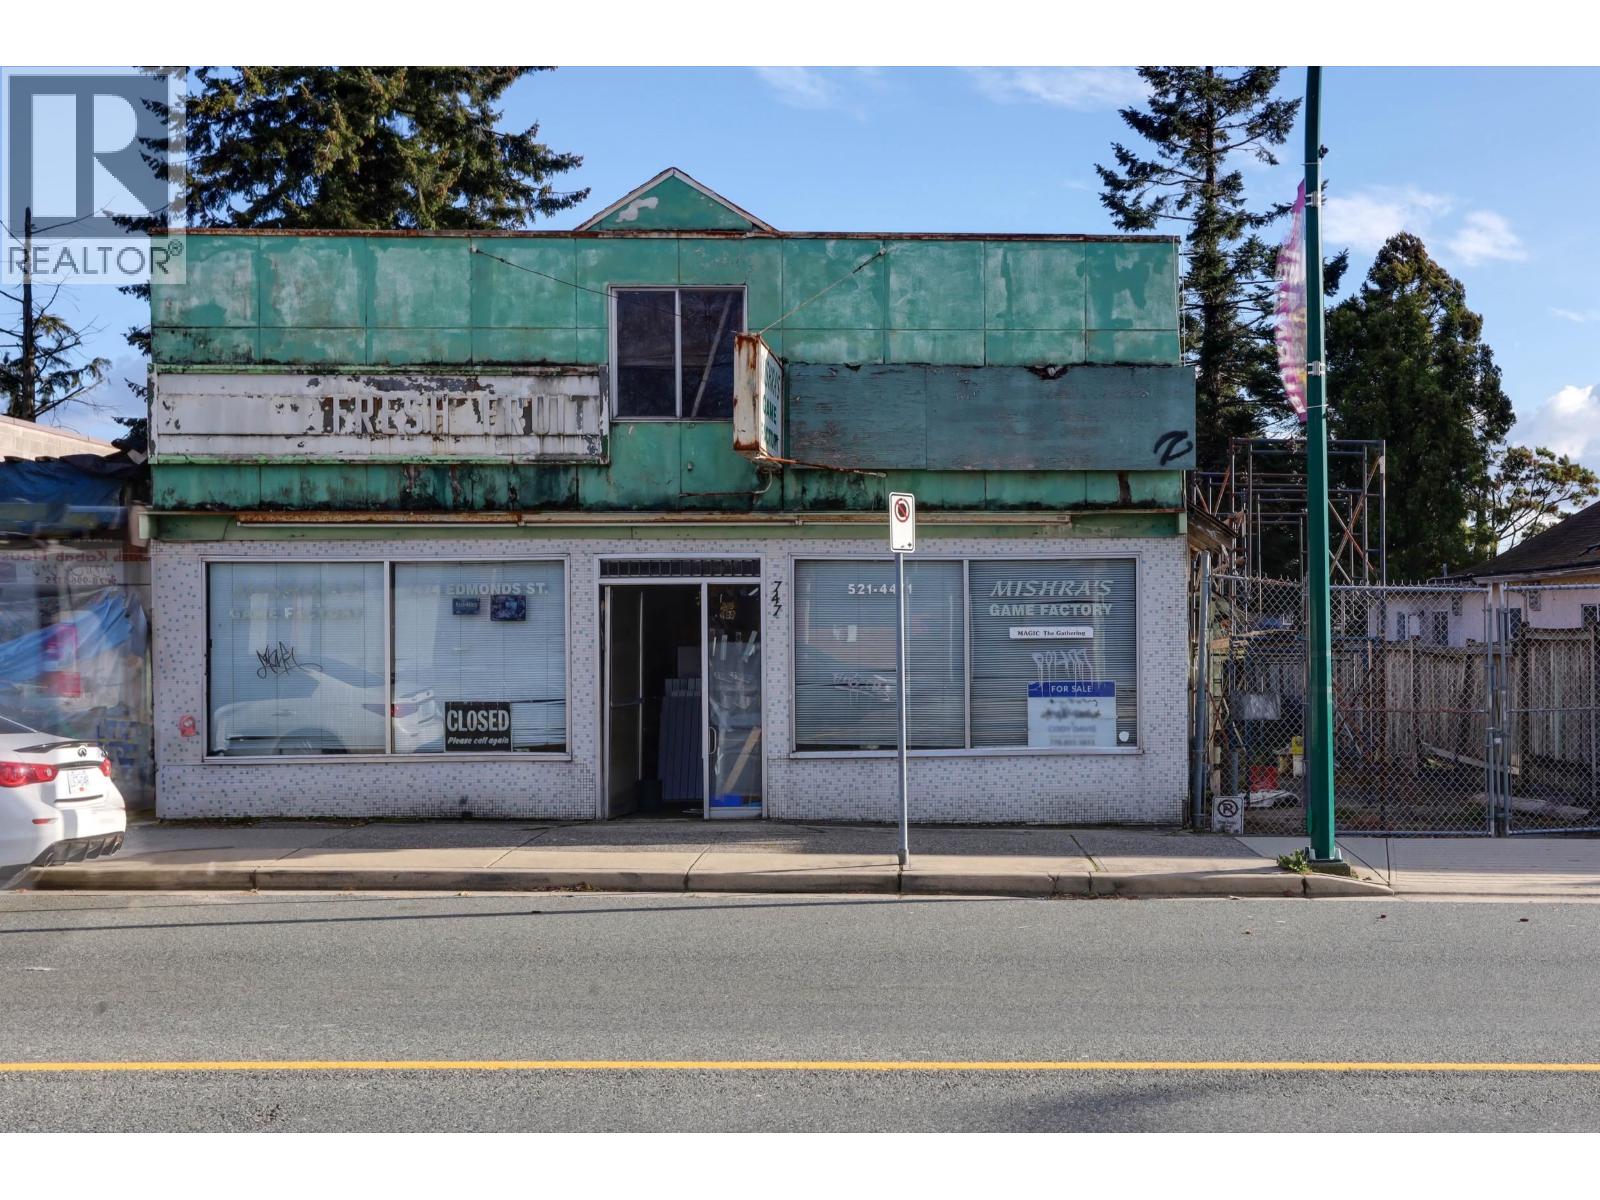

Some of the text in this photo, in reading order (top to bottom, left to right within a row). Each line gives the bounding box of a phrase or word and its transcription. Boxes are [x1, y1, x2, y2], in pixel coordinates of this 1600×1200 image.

[332, 395, 449, 434] FRESH
[447, 582, 521, 596] EDMONDS
[526, 582, 549, 595] ST.
[847, 583, 912, 595] 521-441
[990, 580, 1114, 597] MISHRA'S
[989, 603, 1113, 616] GAME FACTORY
[1017, 629, 1086, 638] MAGIC The Gathering
[1051, 685, 1093, 693] FOR SALE
[446, 709, 510, 732] CLOSED
[448, 736, 509, 747] Please call again
